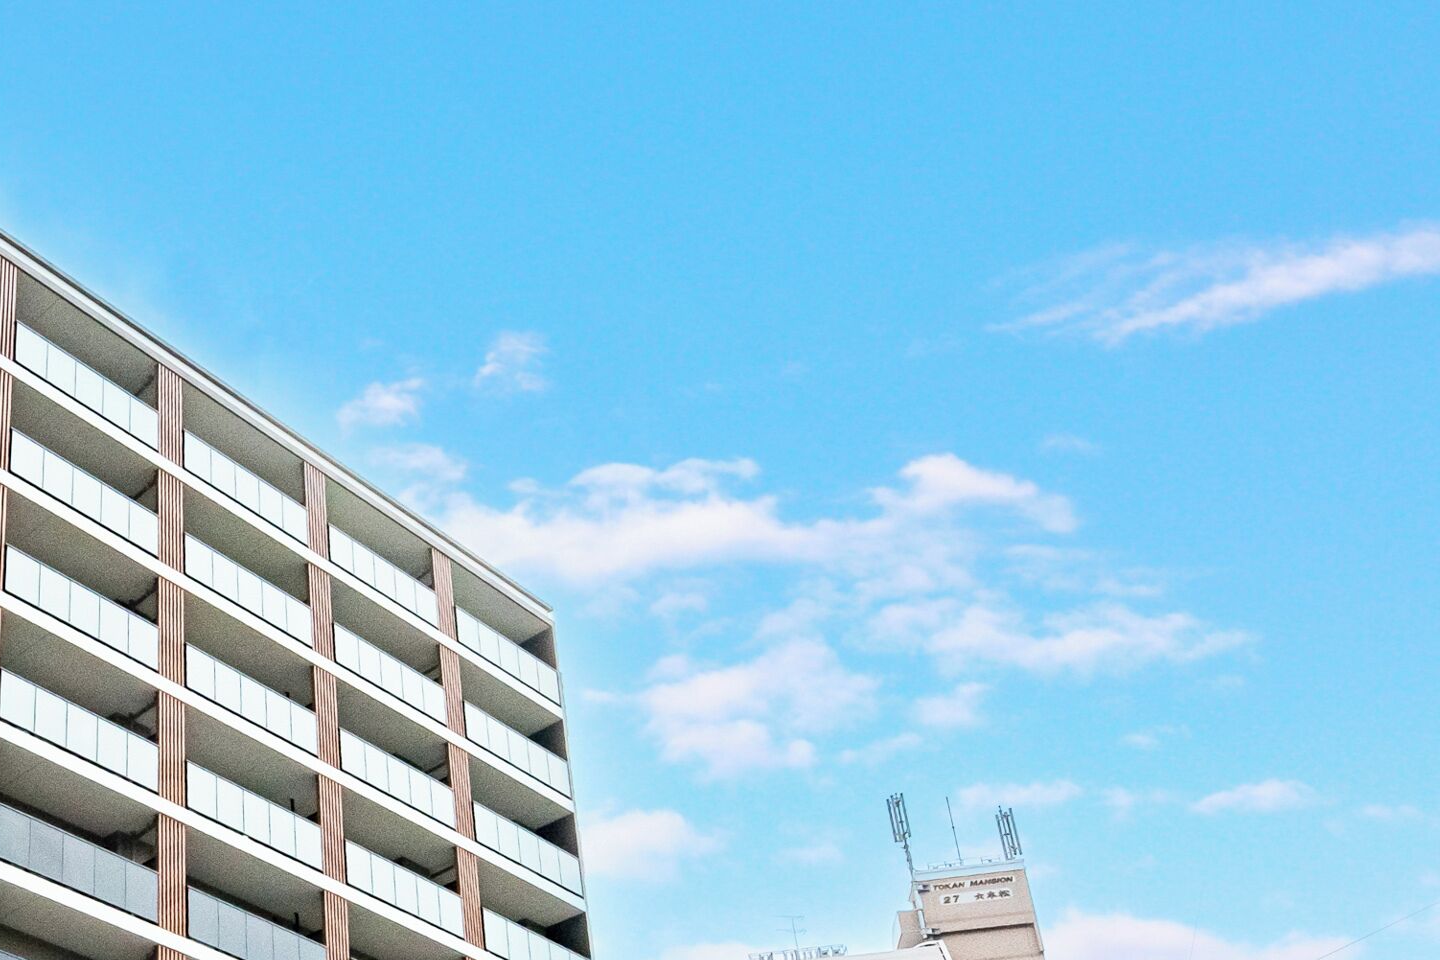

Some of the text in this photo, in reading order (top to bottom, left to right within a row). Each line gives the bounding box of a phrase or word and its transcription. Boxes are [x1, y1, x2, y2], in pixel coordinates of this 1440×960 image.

[933, 876, 1013, 891] TOKAN MANSION
[943, 895, 960, 904] 27
